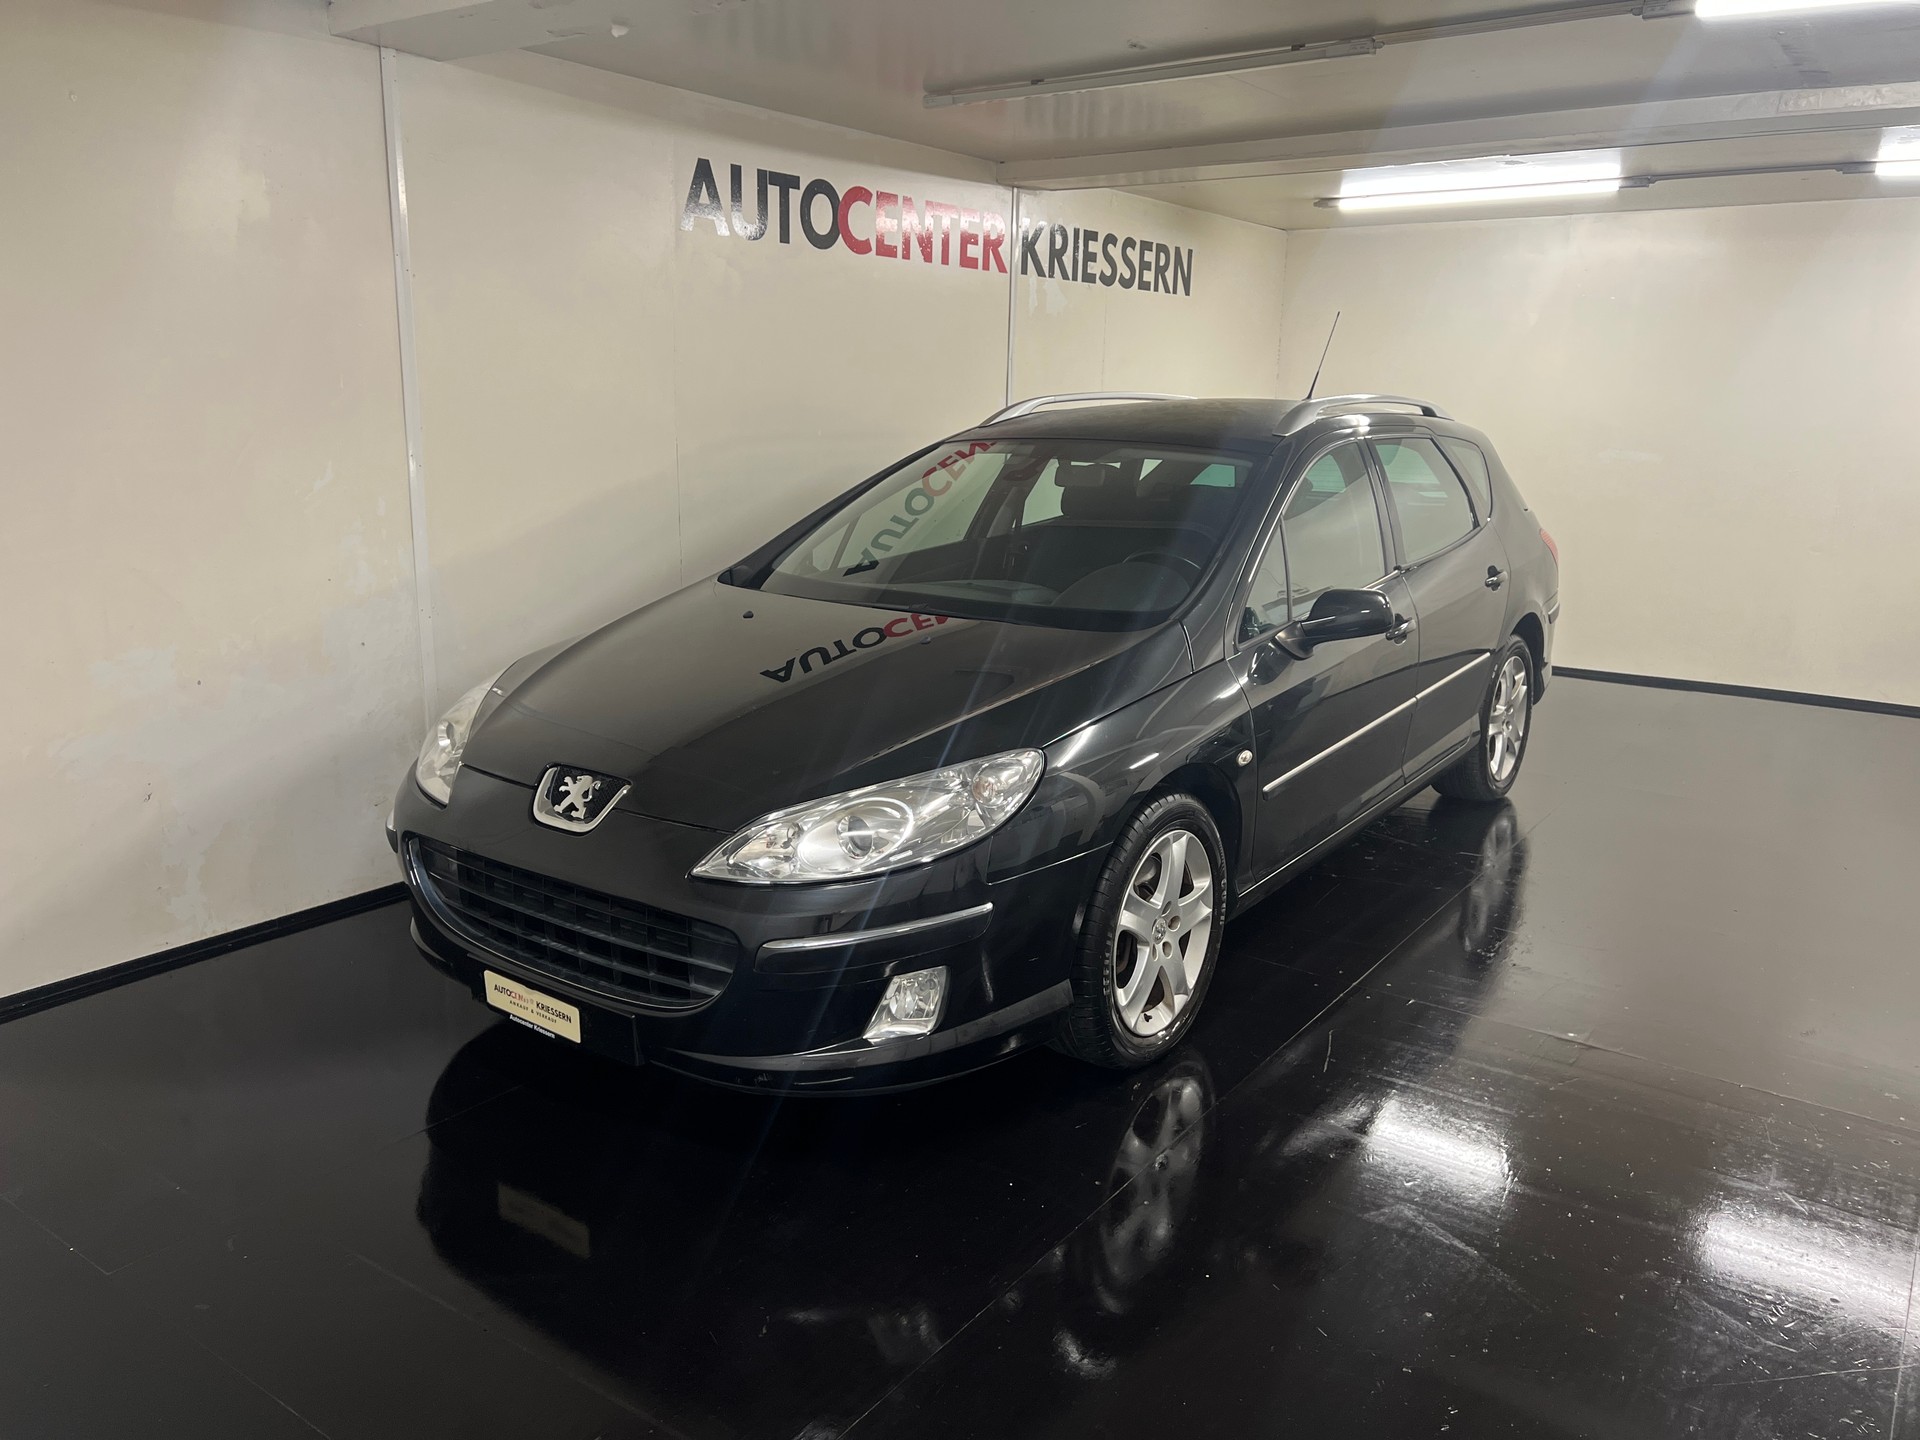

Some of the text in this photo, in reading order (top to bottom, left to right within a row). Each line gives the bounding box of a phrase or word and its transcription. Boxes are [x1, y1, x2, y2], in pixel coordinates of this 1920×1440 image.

[680, 157, 1193, 296] AUTOCENTER KRIESSERN
[536, 1001, 572, 1024] KRIESSERN
